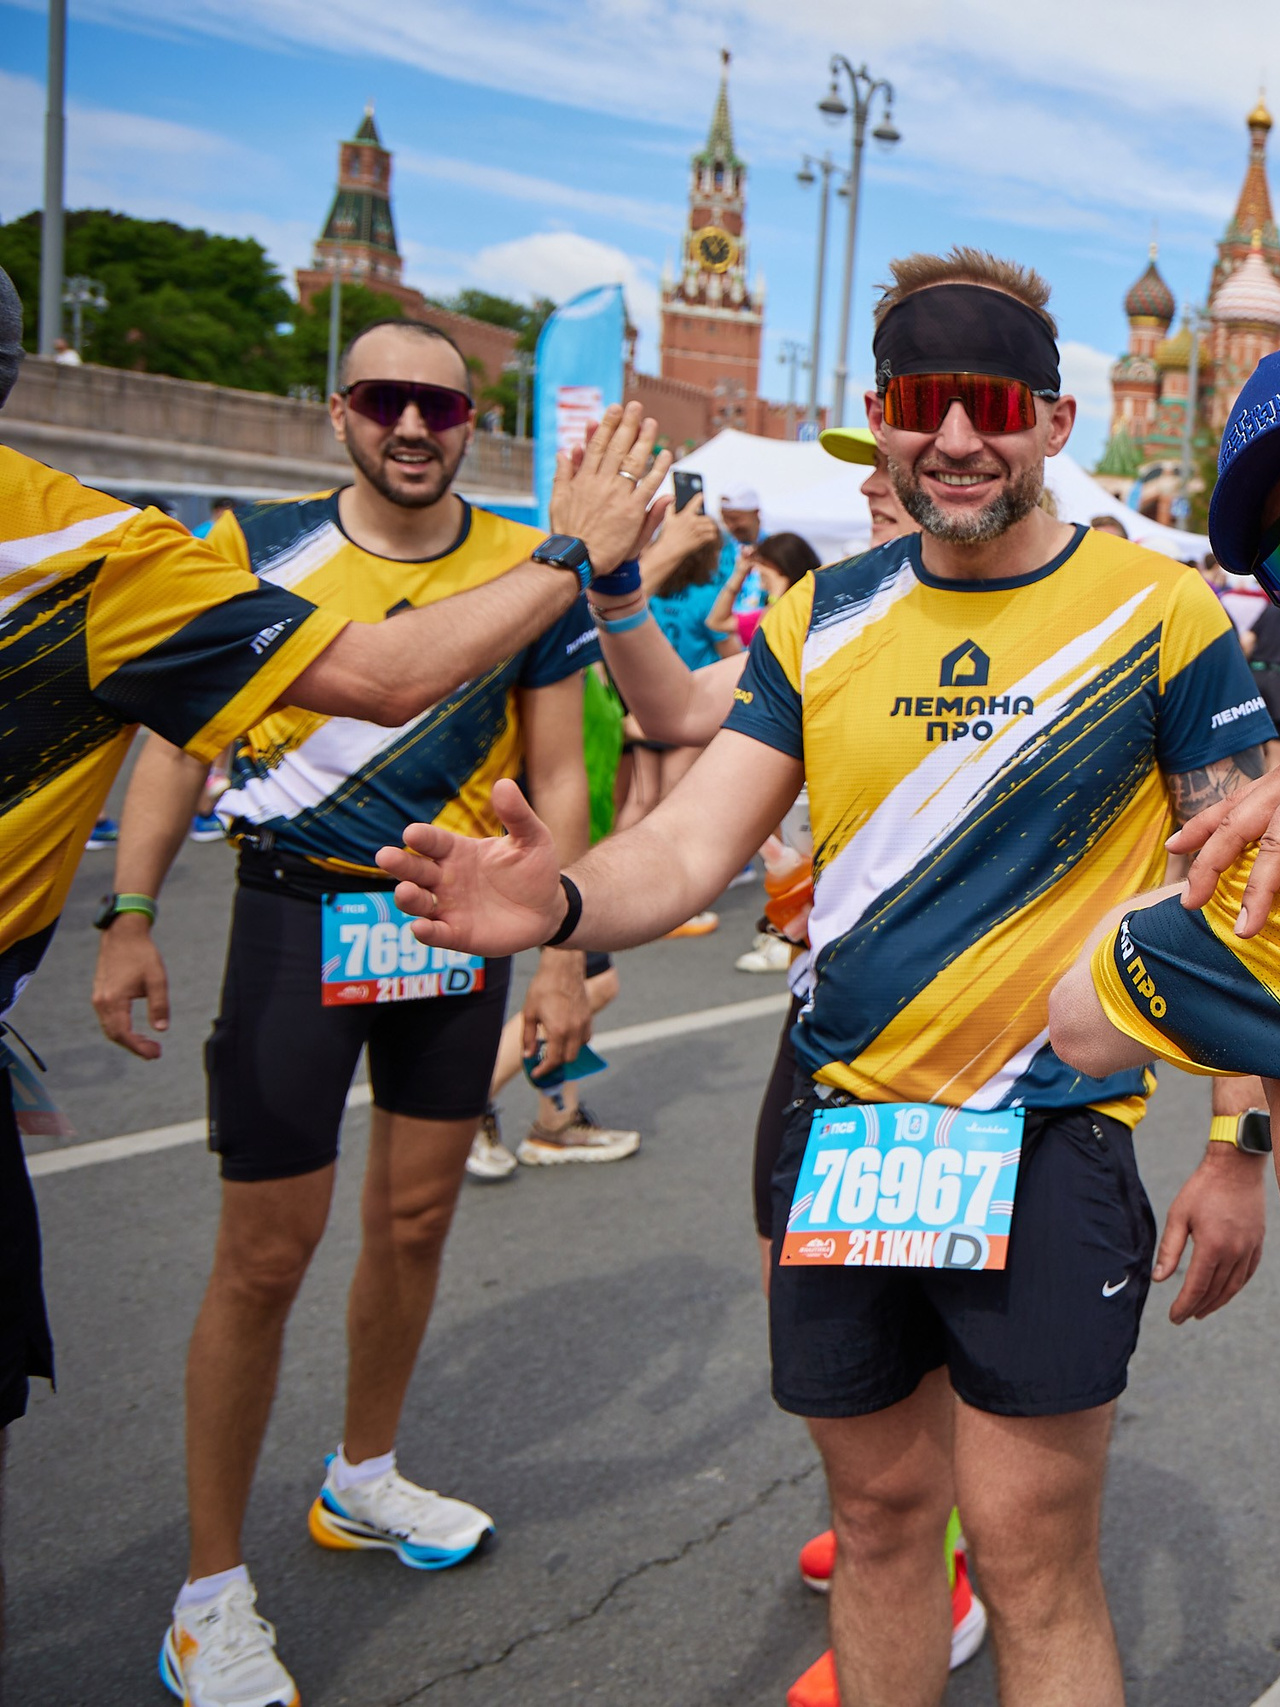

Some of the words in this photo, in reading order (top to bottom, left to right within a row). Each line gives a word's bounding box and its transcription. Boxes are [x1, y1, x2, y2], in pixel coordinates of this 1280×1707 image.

[890, 695, 1034, 717] ЛЕМАНА
[1211, 696, 1266, 729] ЛЕМАН
[926, 720, 993, 742] ПРО
[447, 968, 471, 991] D
[1126, 955, 1167, 1018] ПРО
[808, 1146, 1003, 1226] 76967
[944, 1232, 982, 1269] D
